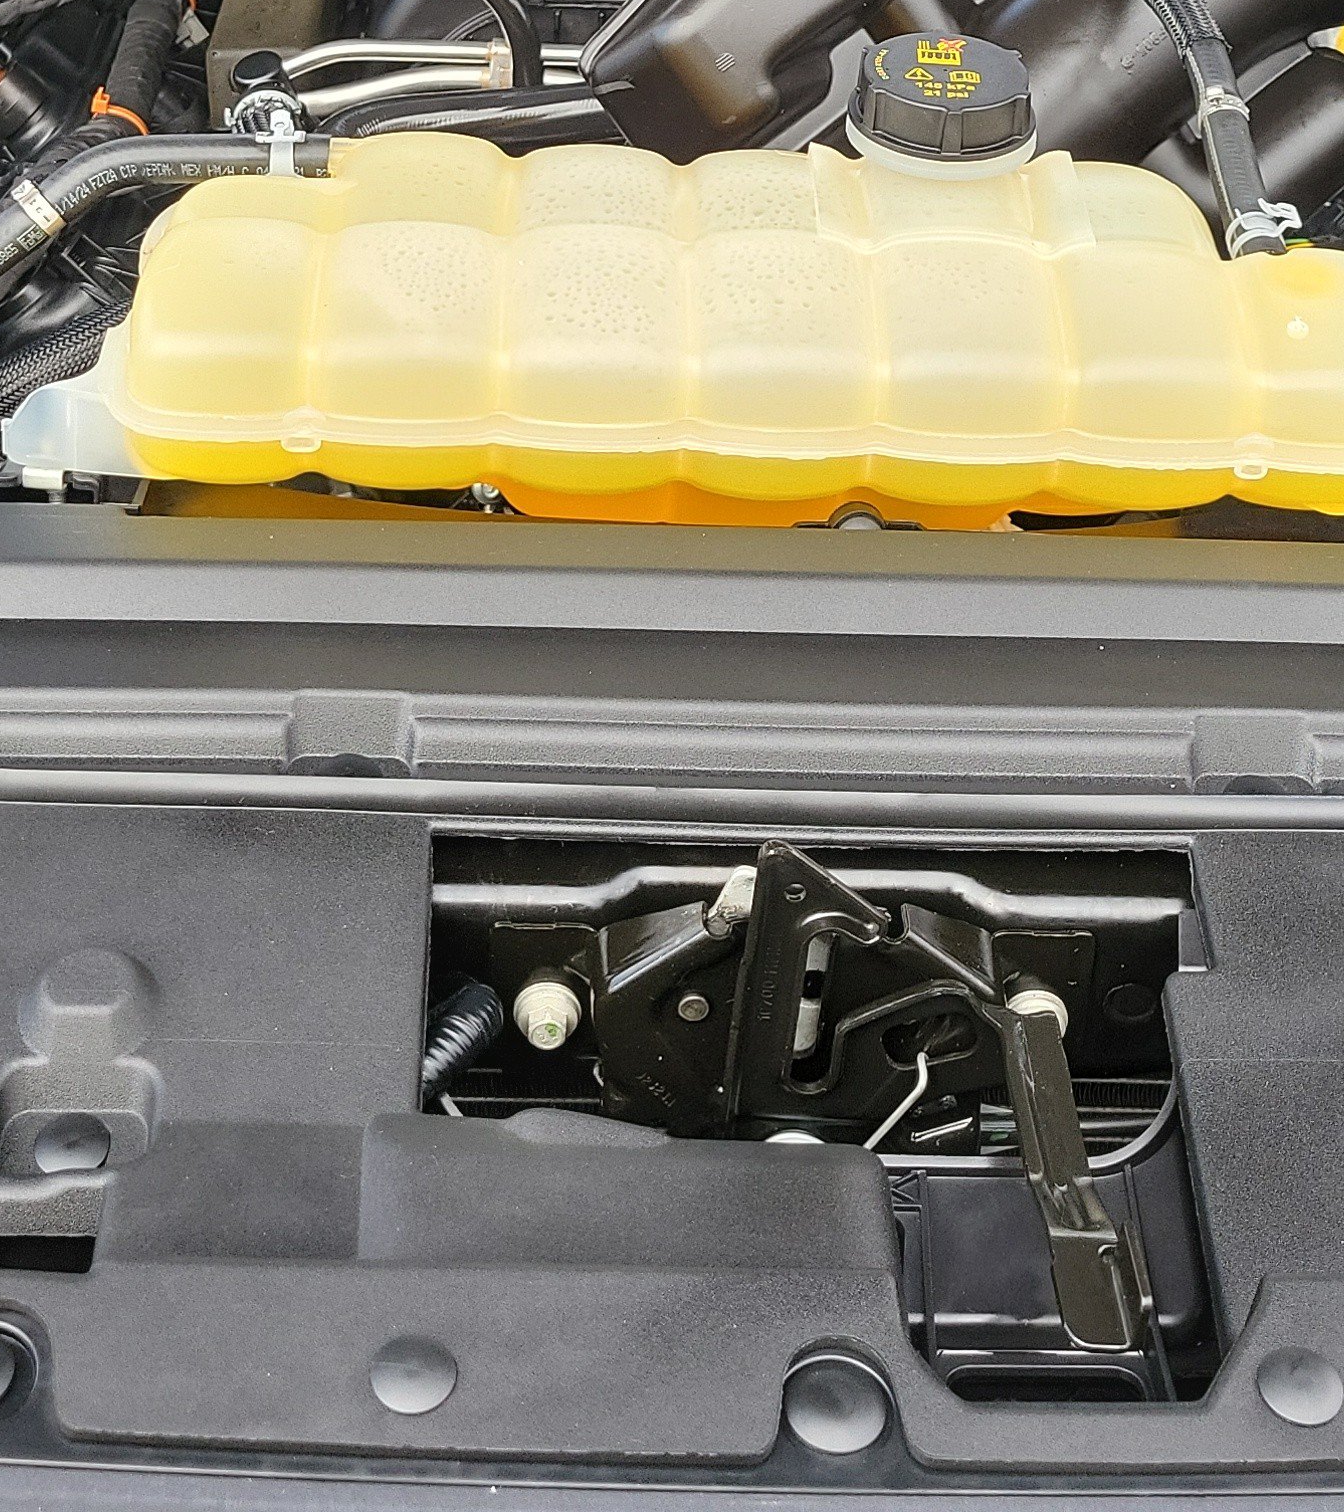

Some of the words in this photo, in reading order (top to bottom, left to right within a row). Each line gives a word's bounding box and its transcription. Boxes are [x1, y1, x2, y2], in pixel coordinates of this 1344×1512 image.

[915, 81, 943, 90] 140
[946, 82, 976, 92] kPa
[923, 89, 941, 97] 21
[946, 90, 970, 99] psi
